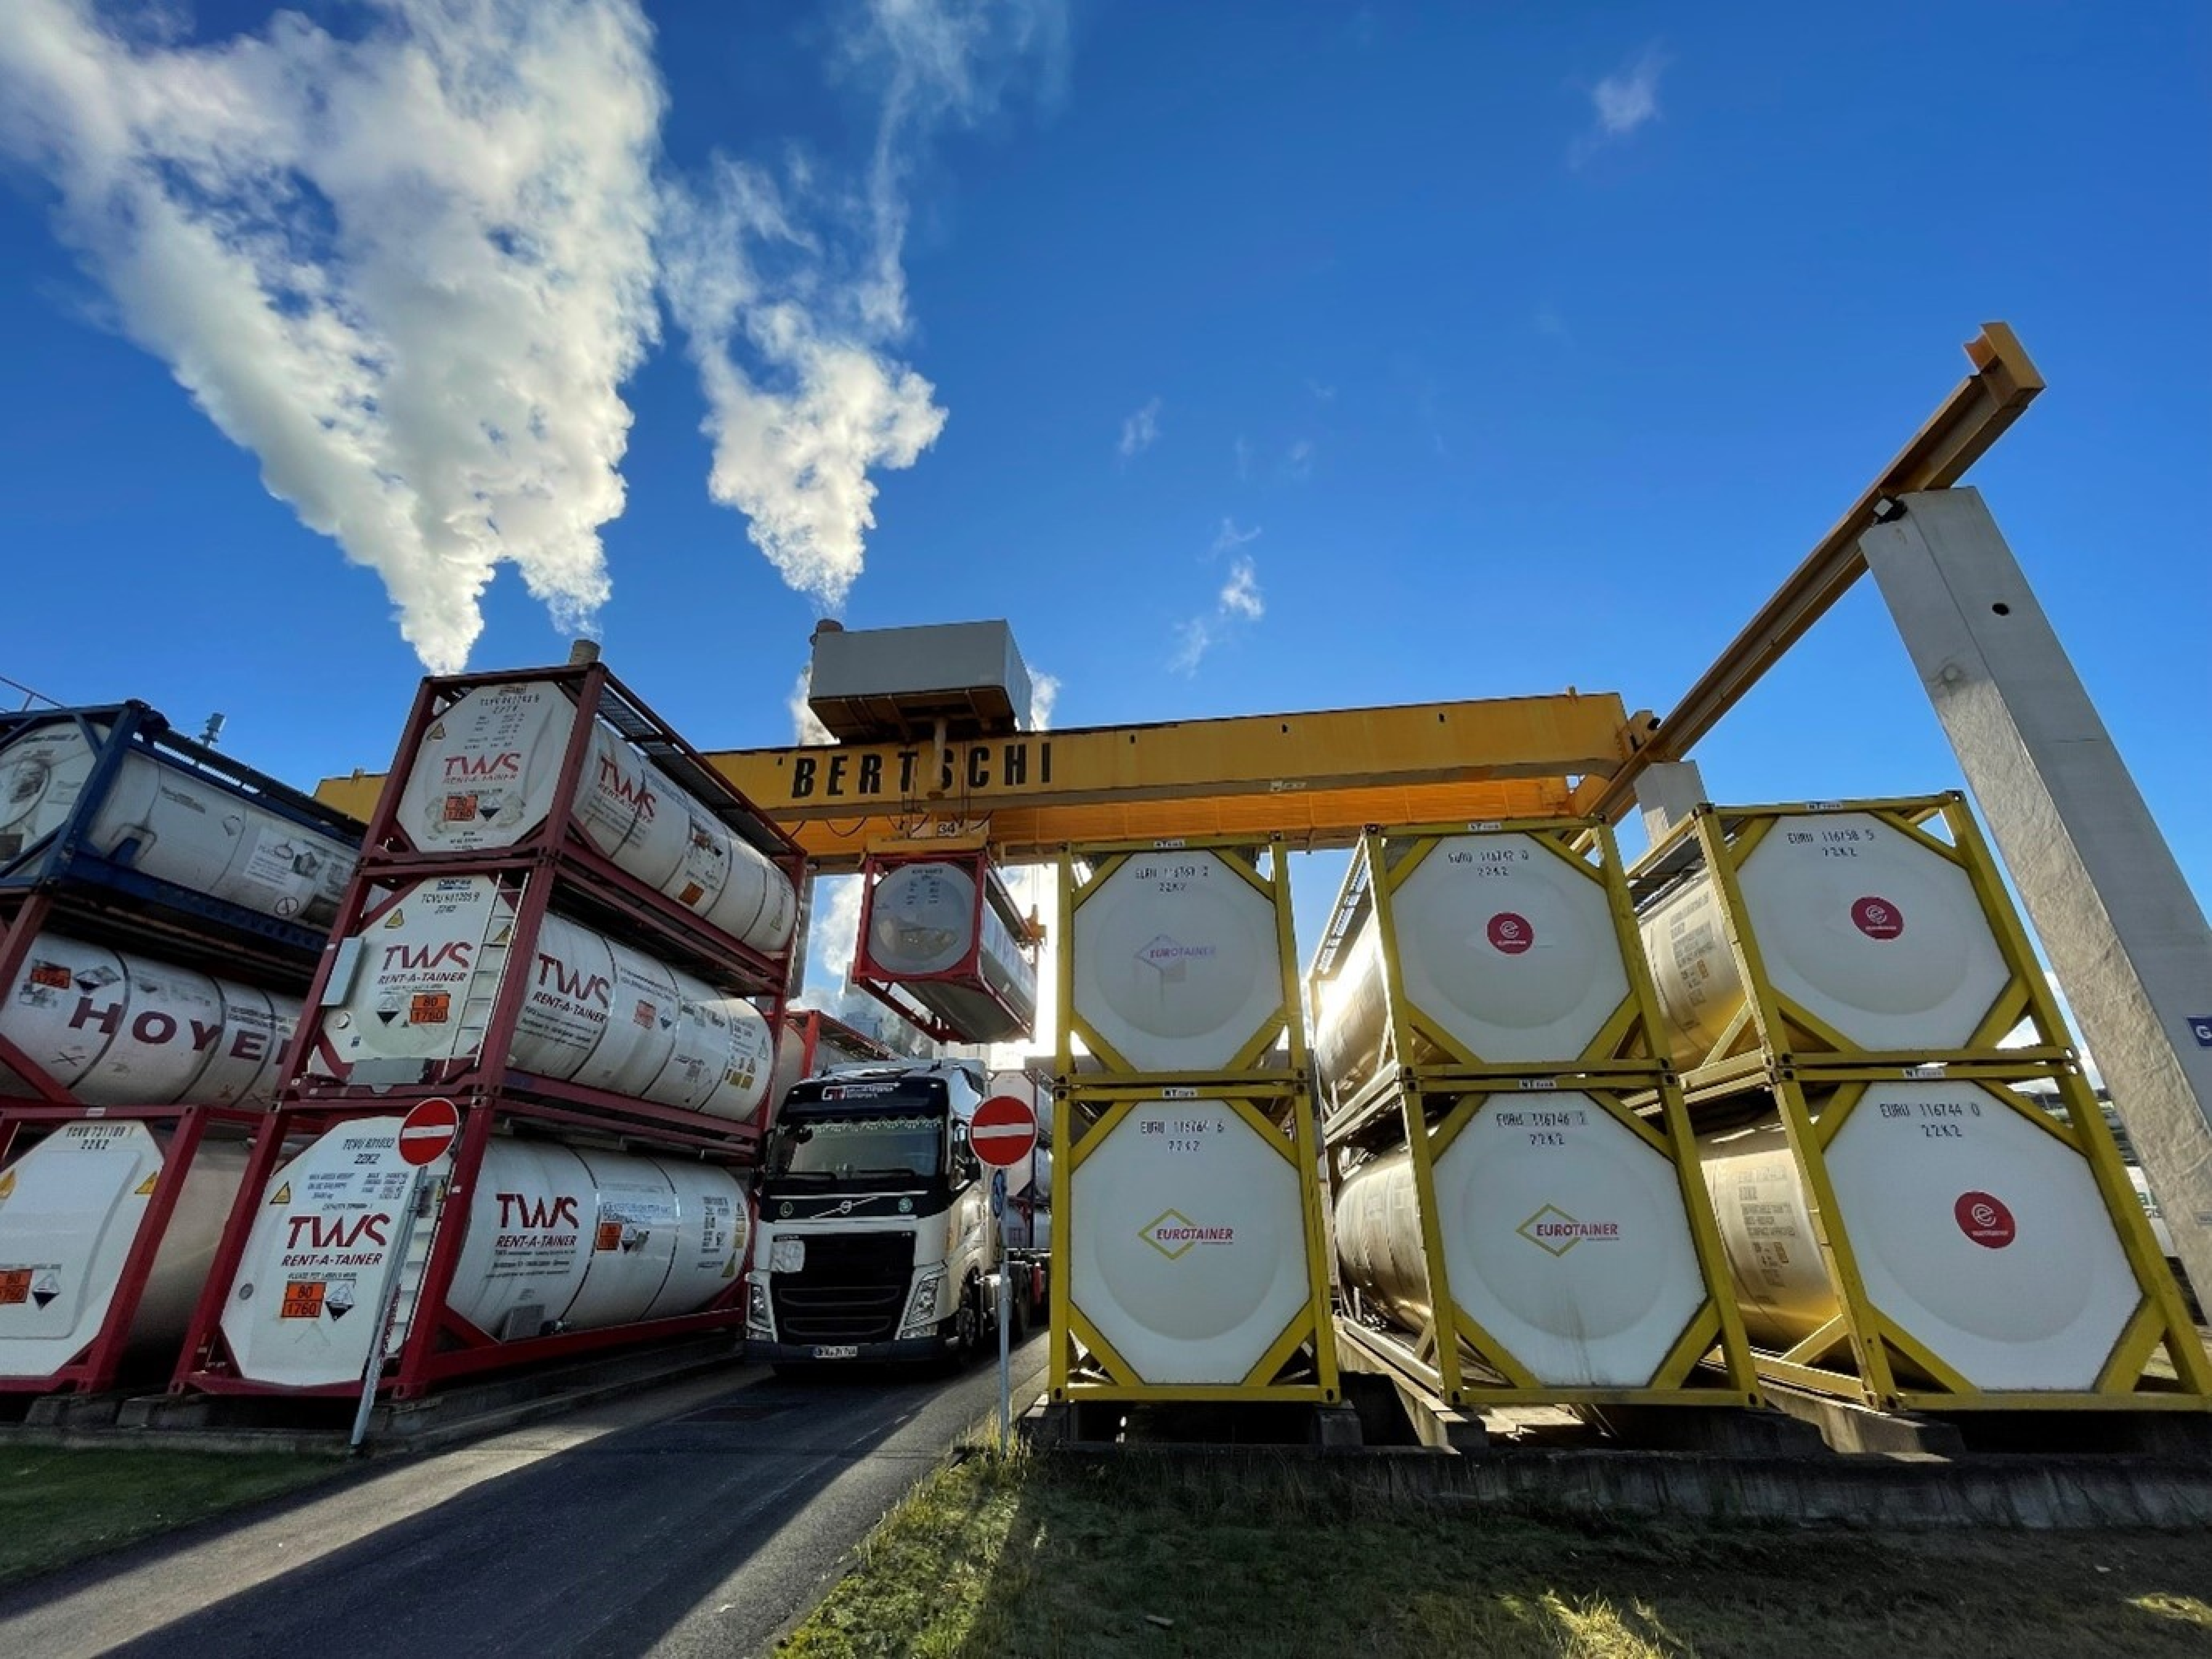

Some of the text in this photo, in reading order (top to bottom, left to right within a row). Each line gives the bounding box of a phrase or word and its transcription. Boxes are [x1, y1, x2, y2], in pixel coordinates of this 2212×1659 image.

[444, 752, 521, 775] TWS
[601, 756, 656, 817] TWS
[383, 942, 473, 971] TWS
[377, 971, 467, 984] RENT-A-TAINER
[538, 952, 611, 1009] TWS
[532, 991, 607, 1024] RENT-A-TAINER
[1879, 1102, 1981, 1118] EURU 116744 0
[1141, 1121, 1165, 1134] EURU
[1921, 1124, 1962, 1138] 22K2
[496, 1194, 578, 1229] TWS
[287, 1213, 391, 1249] TWS
[1156, 1228, 1234, 1241] EUROTAINER
[1535, 1223, 1619, 1237] EUROTAINER
[495, 1235, 577, 1247] RENT-A-TAINER
[281, 1253, 382, 1267] RENT-A-TAINER
[298, 1285, 313, 1299] 80
[286, 1302, 317, 1315] 1760
